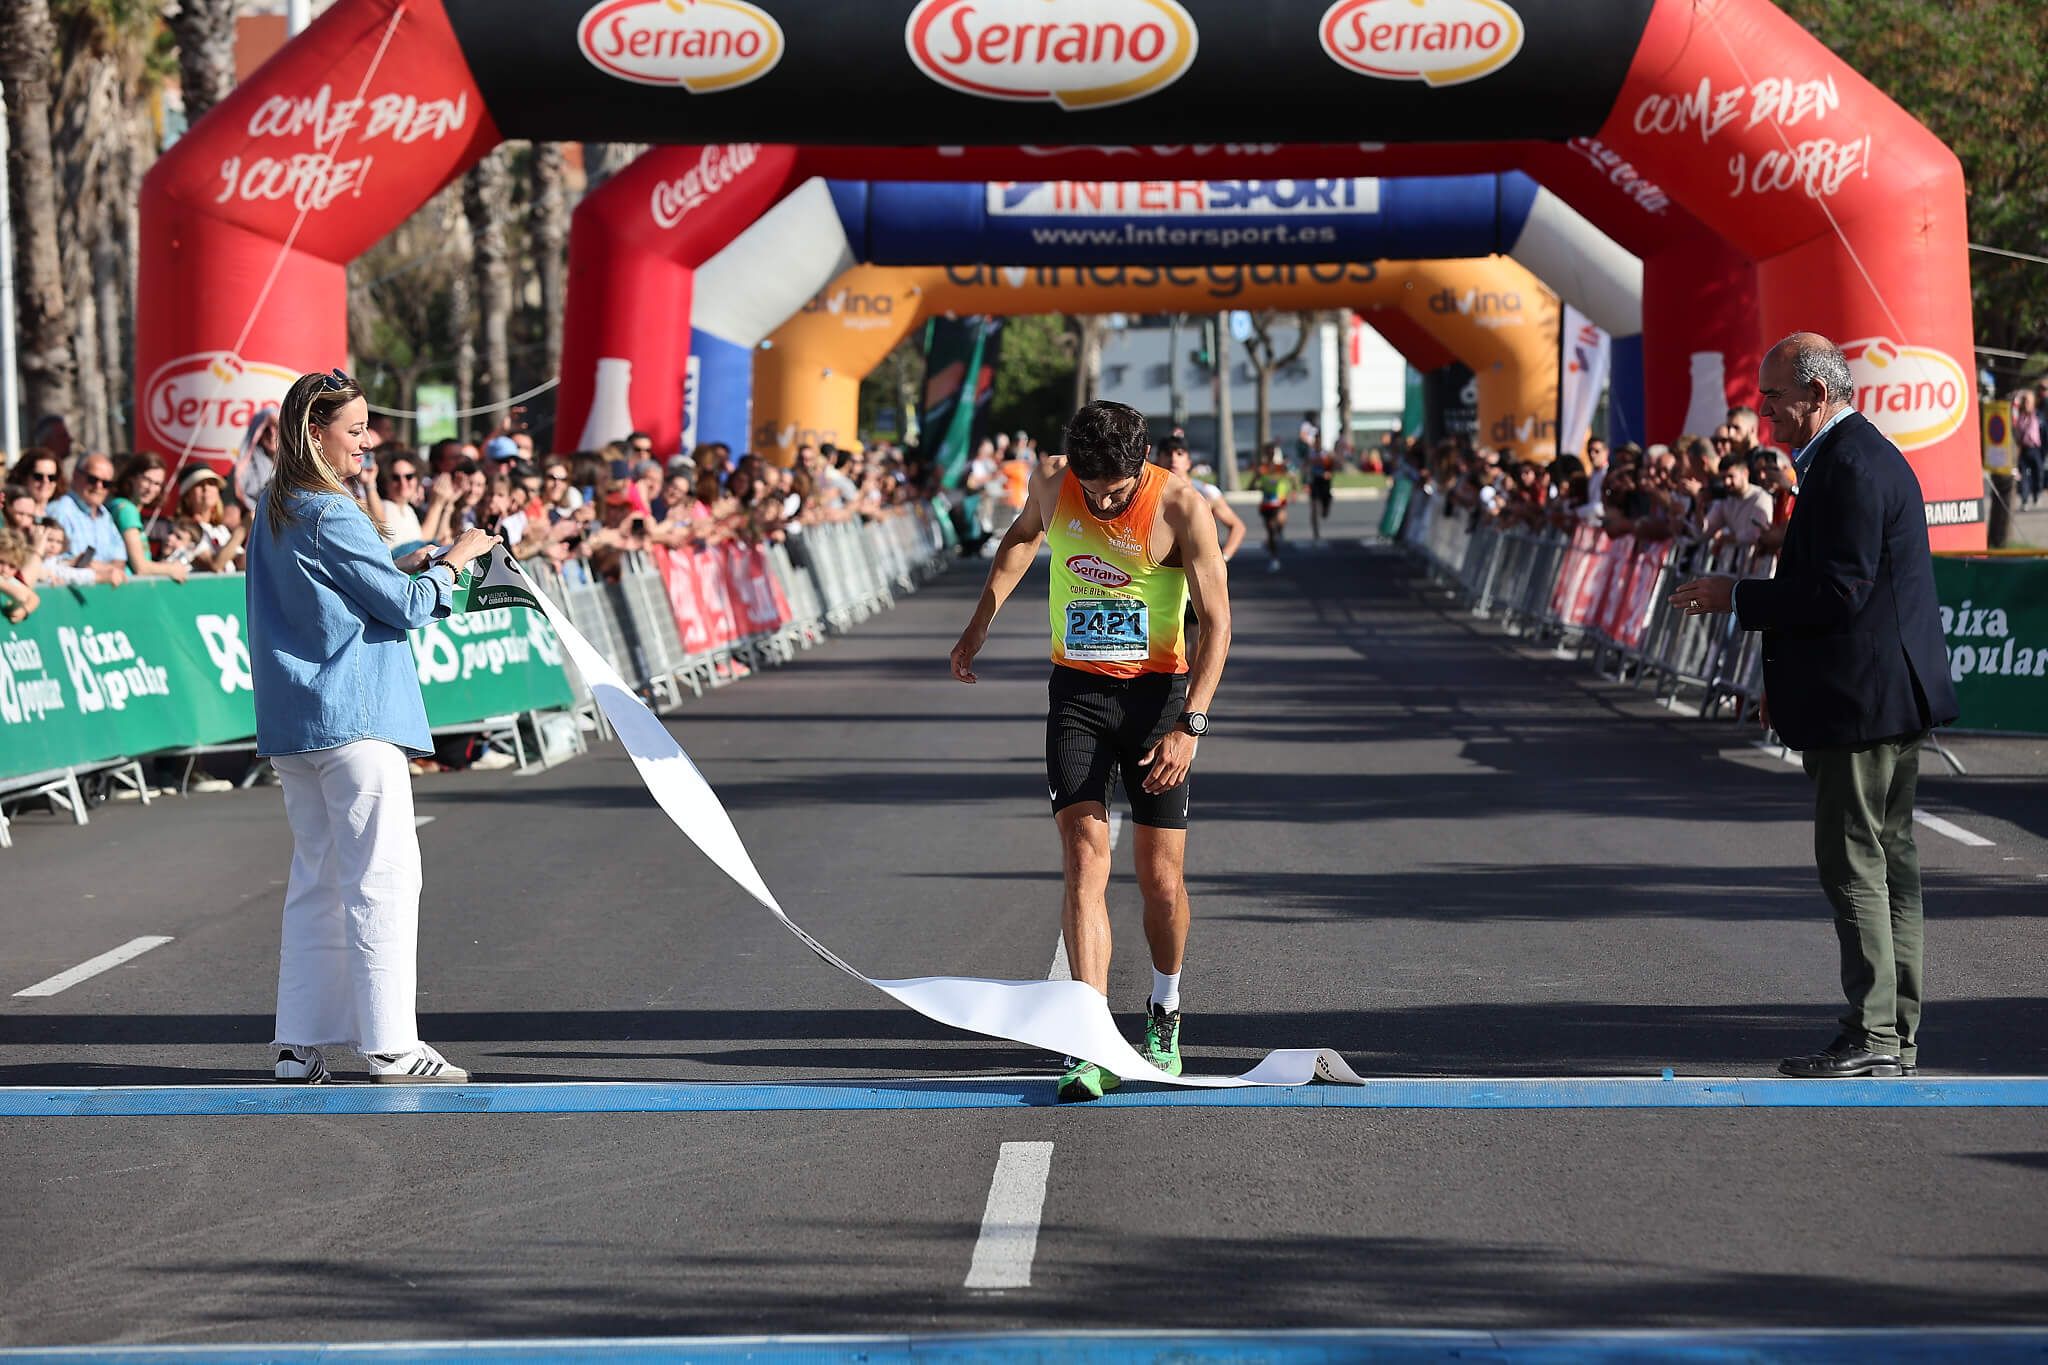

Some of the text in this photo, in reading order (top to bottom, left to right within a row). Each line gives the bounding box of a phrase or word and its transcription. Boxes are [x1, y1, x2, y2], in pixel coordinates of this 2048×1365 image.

[604, 15, 761, 58] Serrano
[940, 5, 1165, 64] Serrano
[1344, 10, 1502, 53] Serrano
[248, 84, 467, 150] COME BIEN
[1633, 72, 1839, 144] COME BIEN
[239, 152, 373, 212] CORRE!
[1751, 133, 1881, 199] CORRE!
[1428, 286, 1521, 316] divina
[1853, 380, 1956, 415] rrano
[1108, 538, 1143, 552] SERRANO
[1072, 561, 1125, 580] Serrano
[1071, 612, 1141, 636] 2421
[1947, 637, 2048, 682] pular
